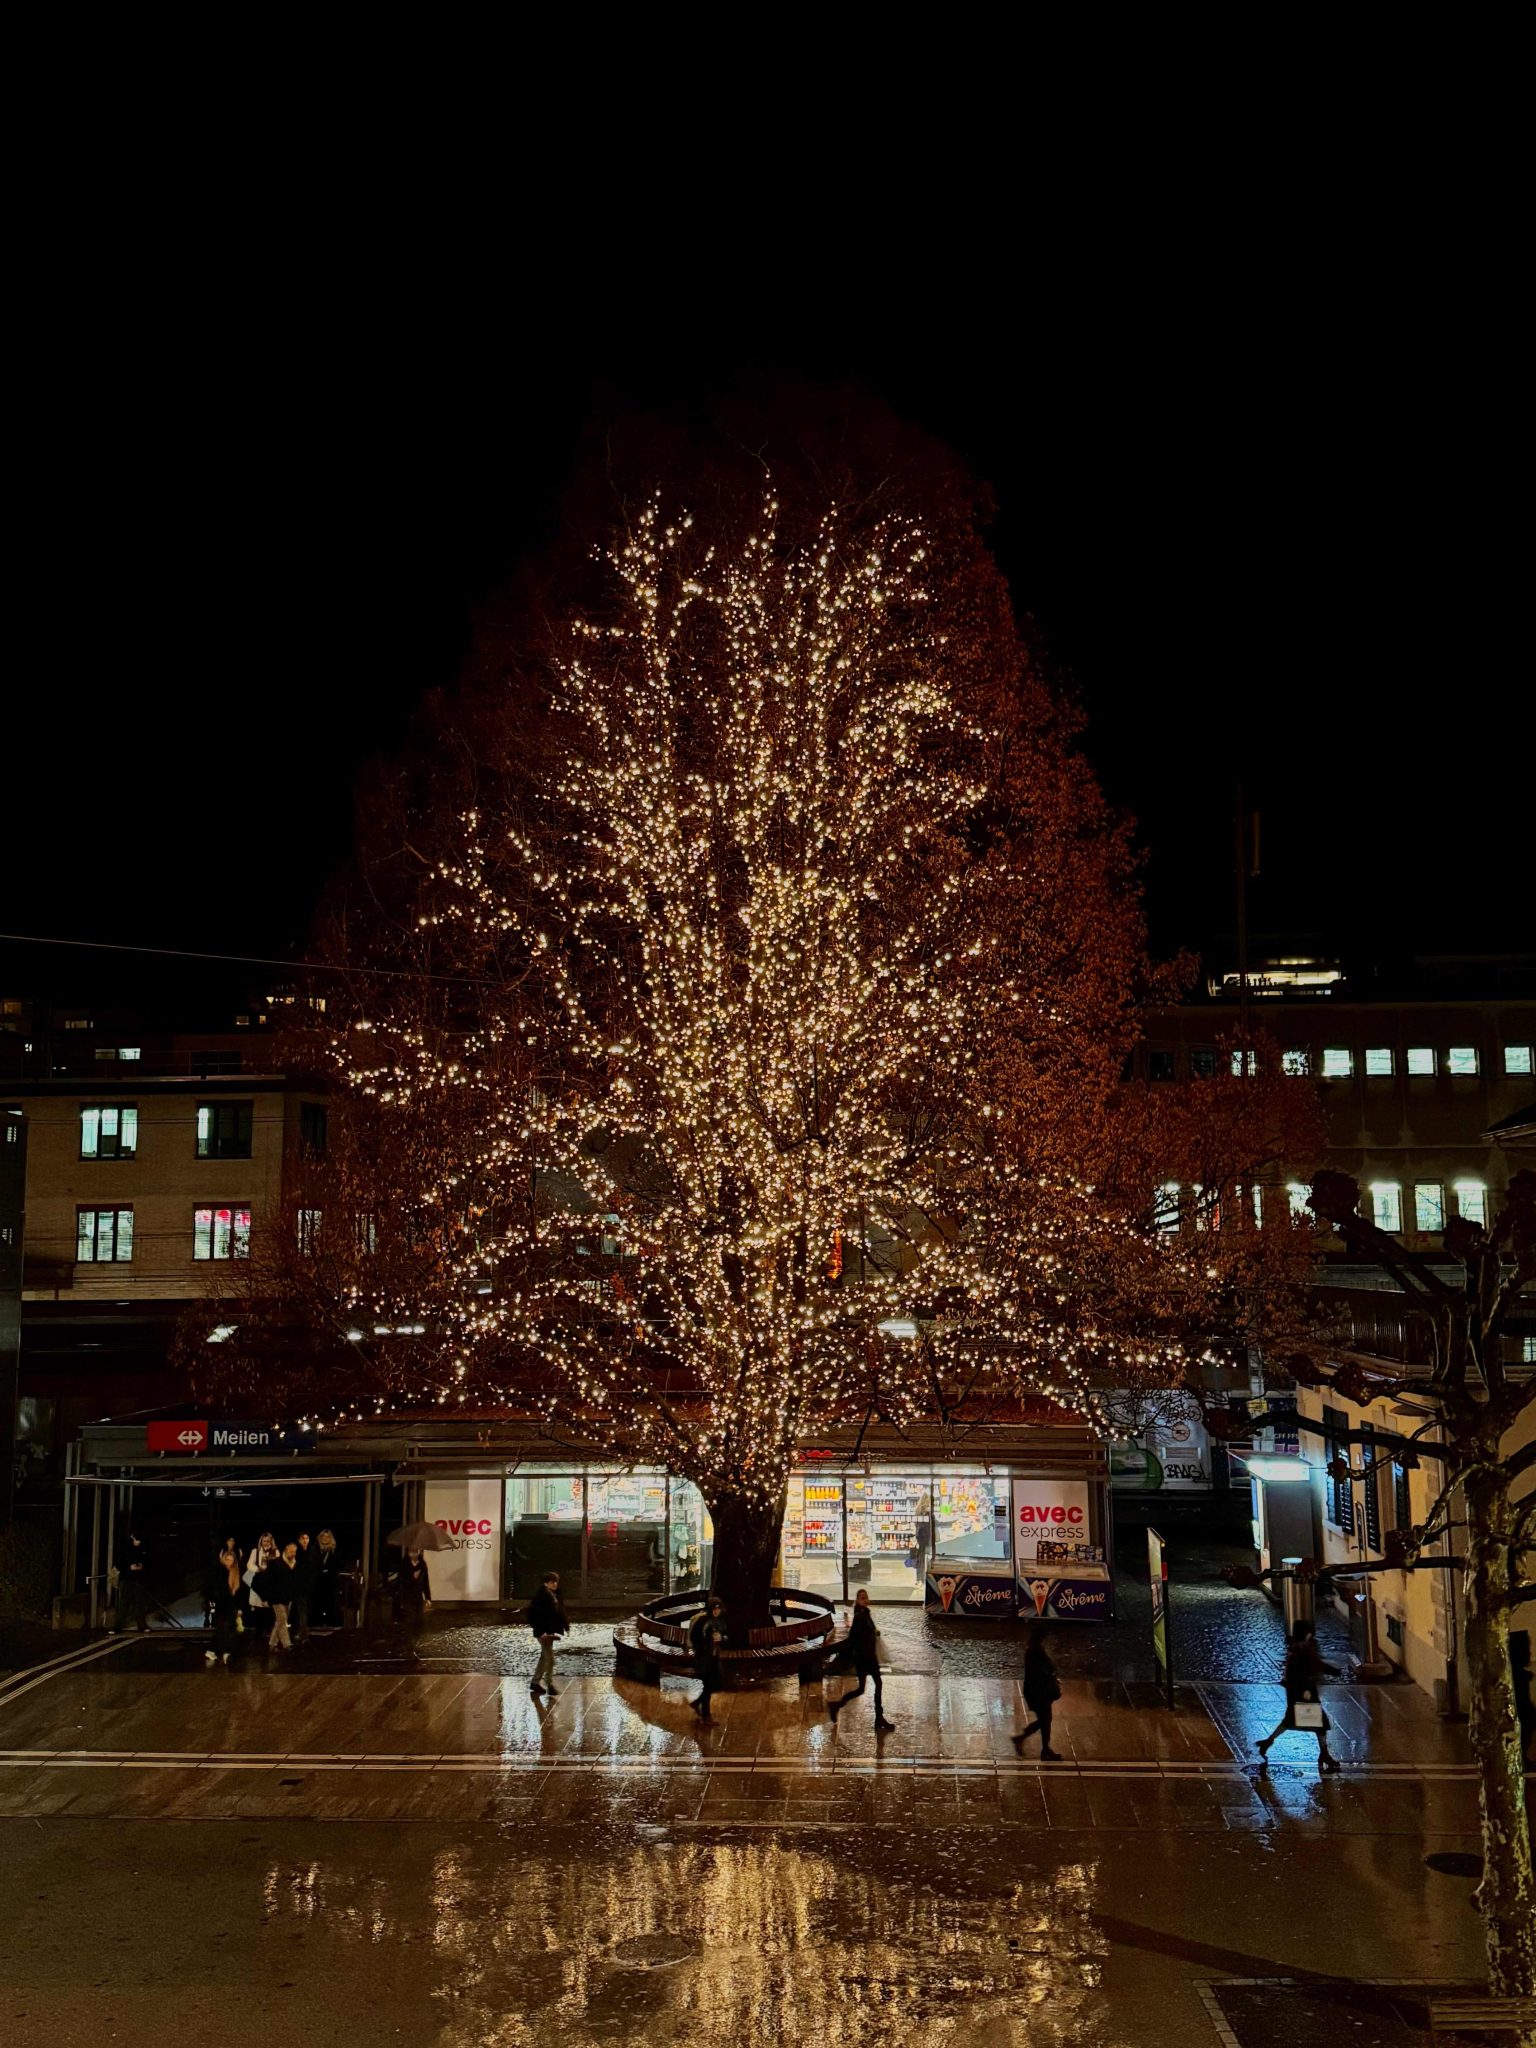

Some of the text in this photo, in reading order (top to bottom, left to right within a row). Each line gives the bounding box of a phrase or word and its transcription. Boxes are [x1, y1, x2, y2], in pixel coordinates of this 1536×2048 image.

[213, 1430, 269, 1445] Meilen
[1020, 1506, 1084, 1523] avec
[1020, 1526, 1084, 1540] express
